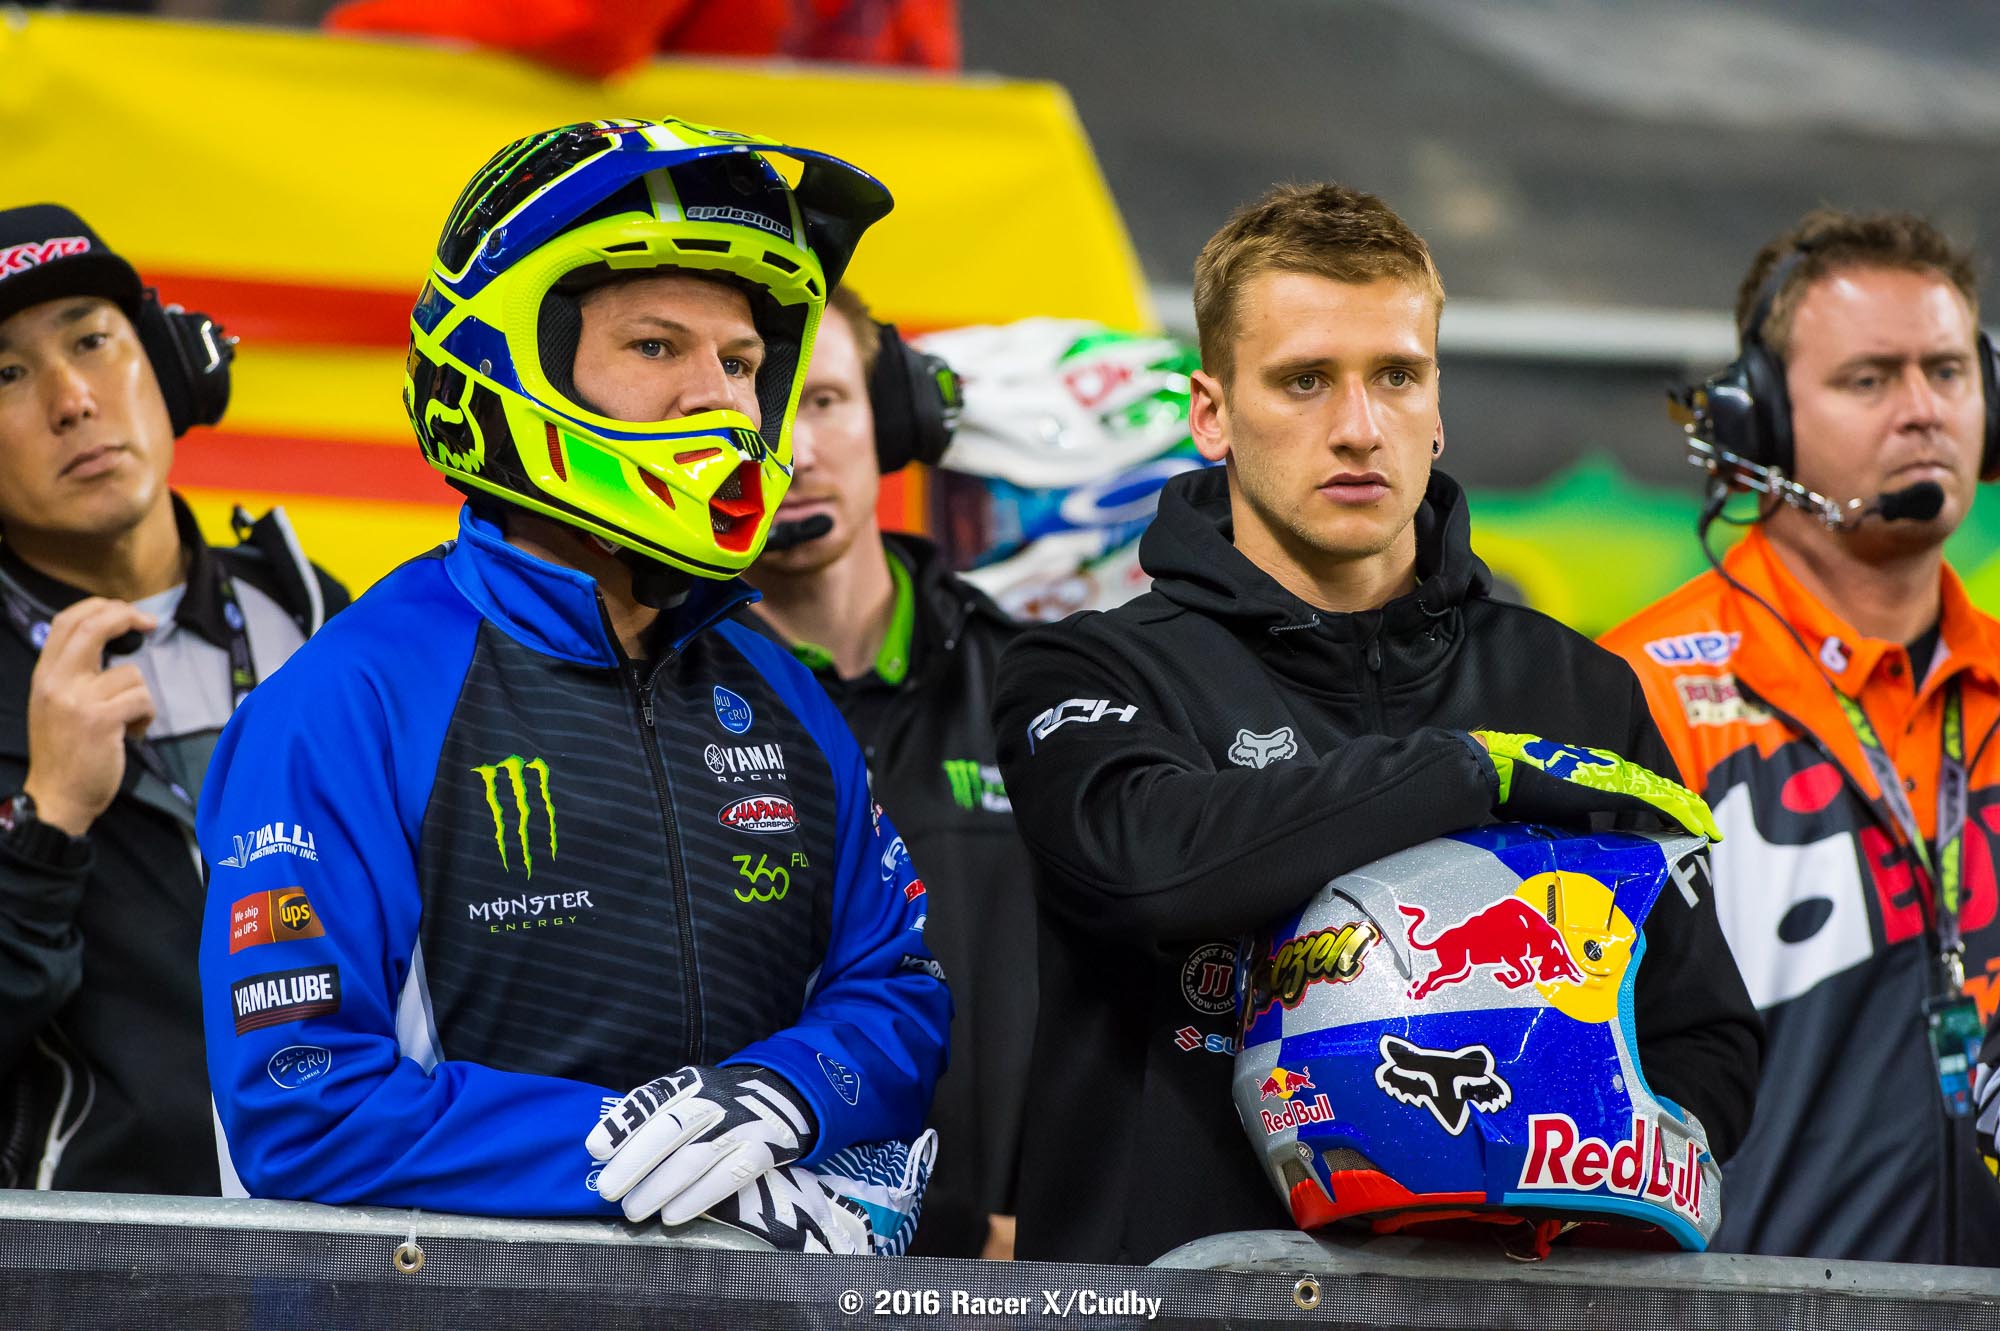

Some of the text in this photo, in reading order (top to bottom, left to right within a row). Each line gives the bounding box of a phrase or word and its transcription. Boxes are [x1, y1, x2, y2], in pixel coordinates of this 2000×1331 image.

[686, 206, 792, 239] apdesigns
[250, 843, 319, 862] CONSTRUCTION INC.
[234, 906, 259, 924] We ship
[281, 904, 310, 927] ups
[468, 890, 594, 922] MONSTER
[234, 921, 258, 940] via UPS
[490, 916, 577, 933] ENERGY
[234, 973, 334, 1017] YAMALUBE
[1260, 1094, 1335, 1135] Red Bull
[1522, 1116, 1647, 1191] Red
